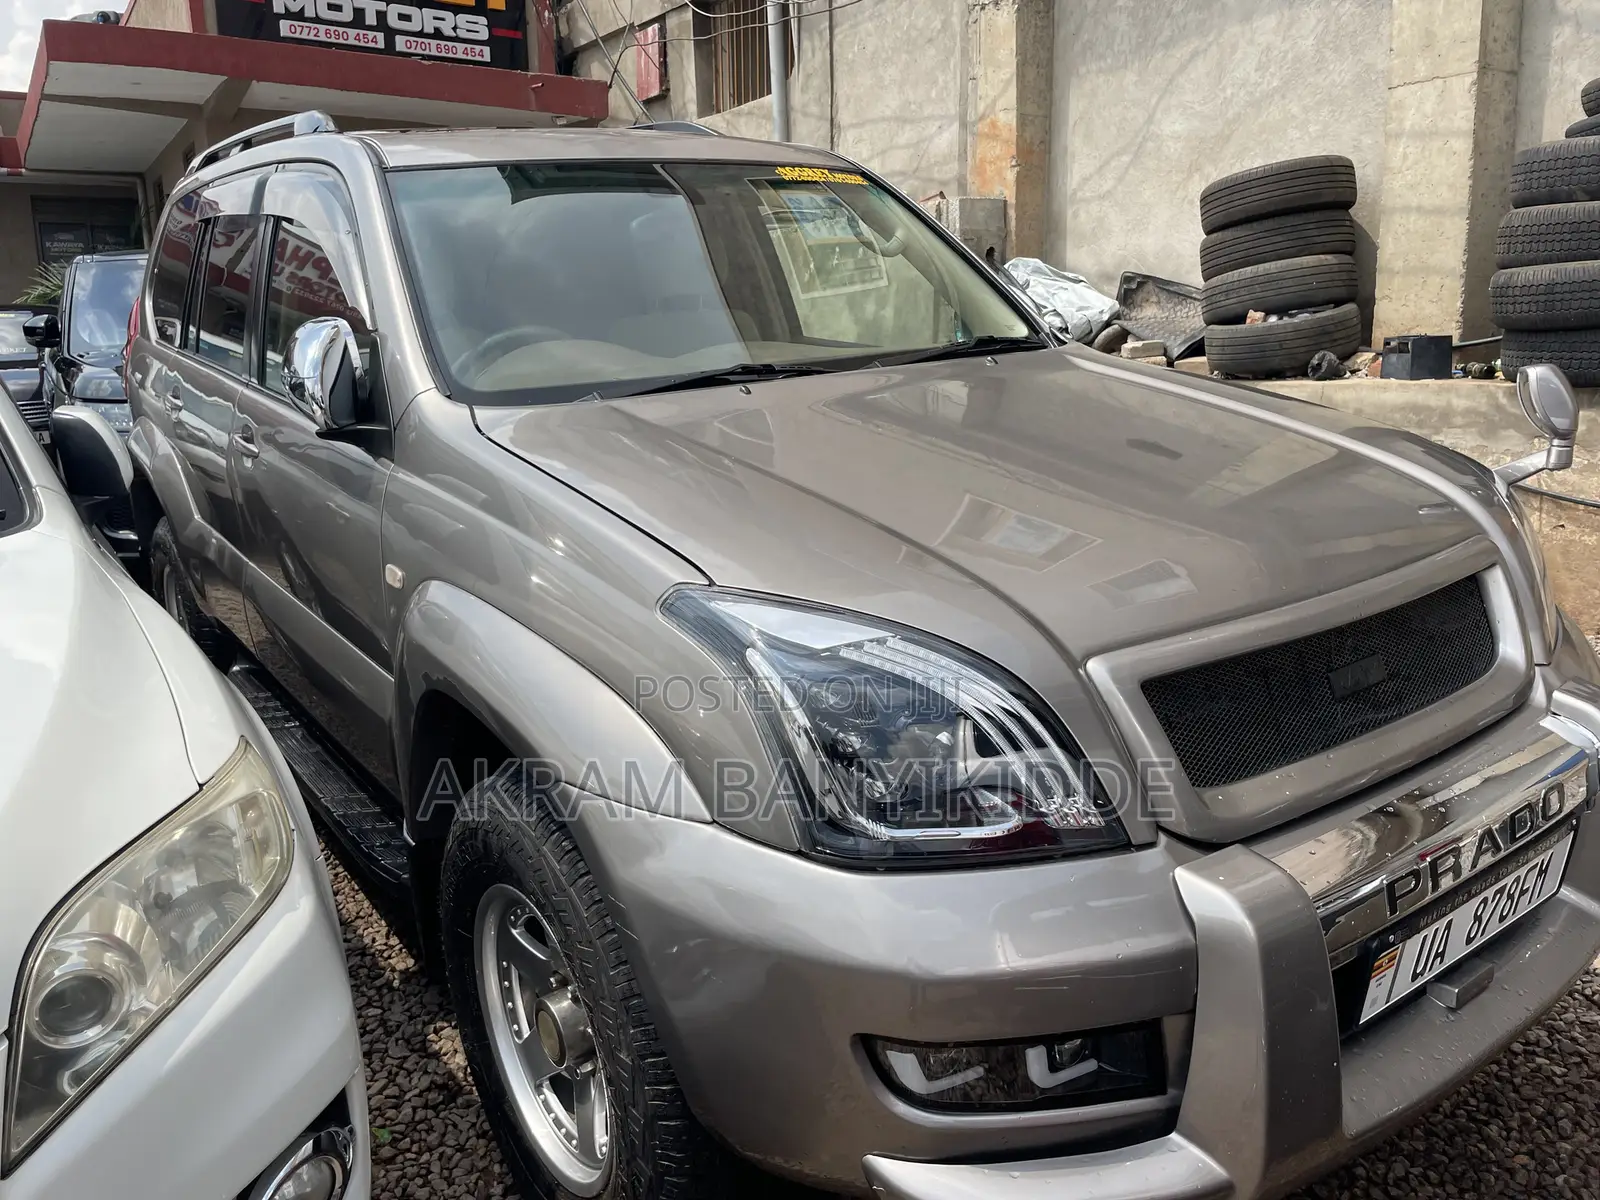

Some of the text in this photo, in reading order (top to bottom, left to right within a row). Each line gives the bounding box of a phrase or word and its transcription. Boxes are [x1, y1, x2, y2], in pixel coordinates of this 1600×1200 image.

[272, 0, 489, 41] MOTORS
[288, 23, 379, 46] 0772 690 454
[404, 39, 485, 59] 0701 690 454
[1383, 782, 1565, 918] PRADO
[1410, 850, 1554, 983] UA 878FM
[1420, 903, 1452, 927] Making
[1454, 893, 1468, 906] the
